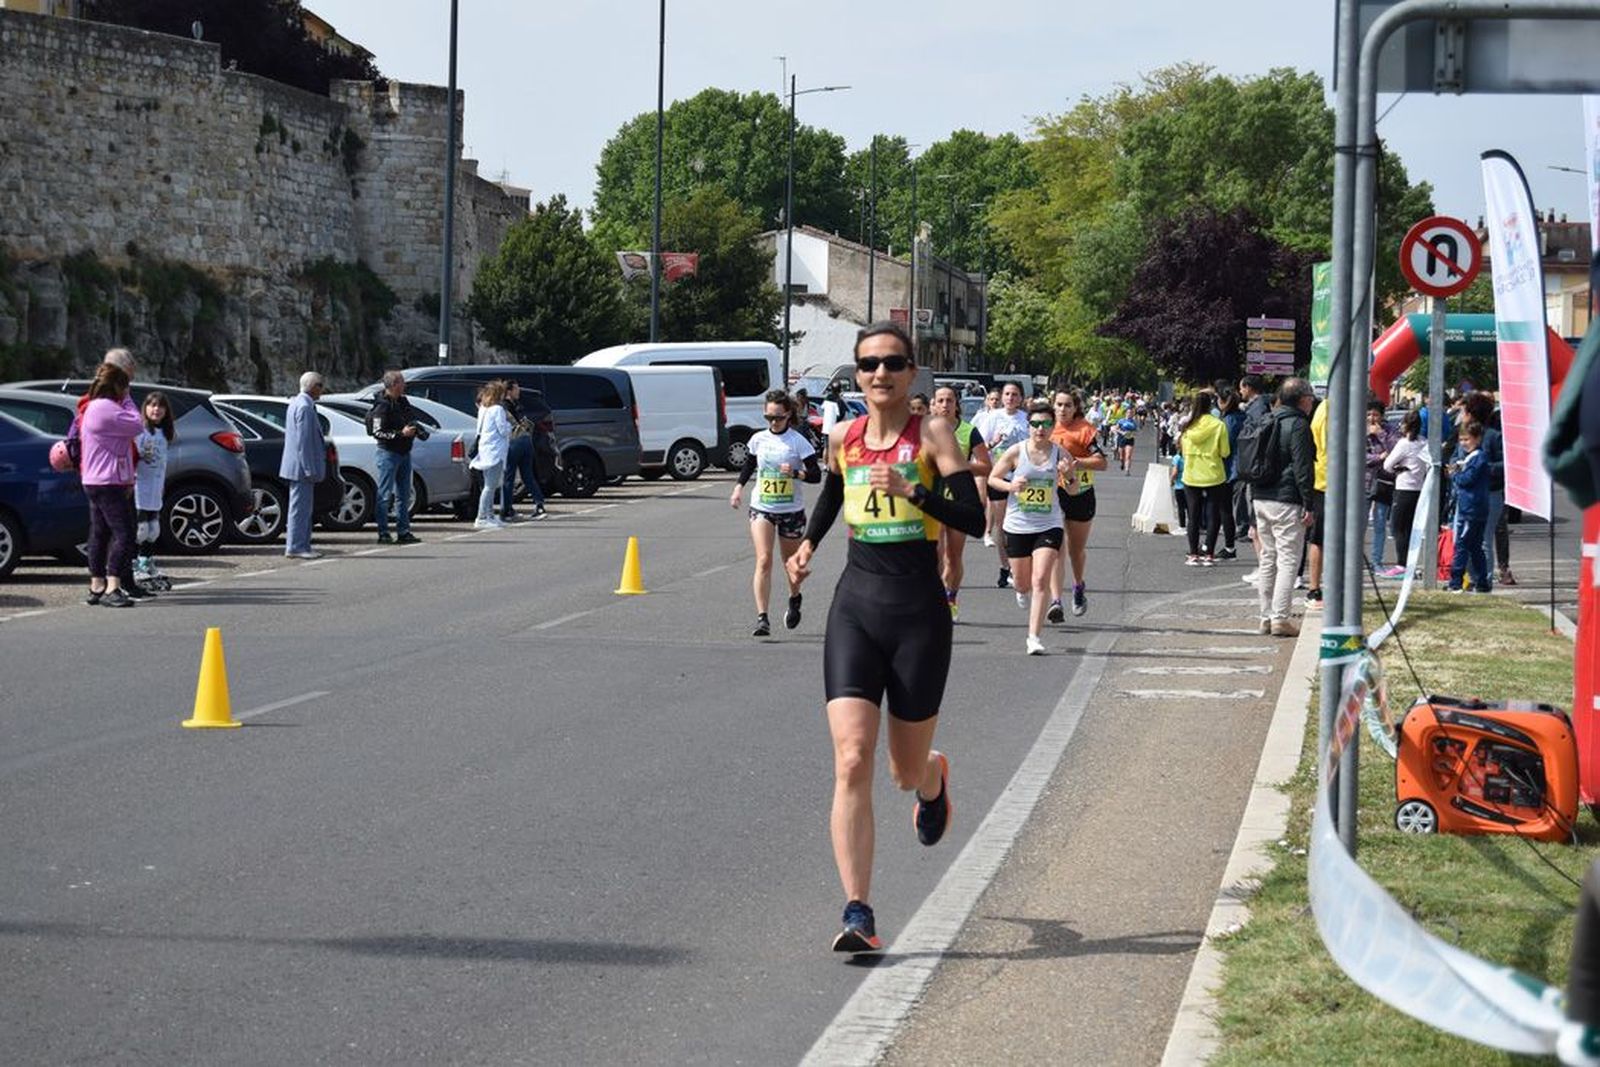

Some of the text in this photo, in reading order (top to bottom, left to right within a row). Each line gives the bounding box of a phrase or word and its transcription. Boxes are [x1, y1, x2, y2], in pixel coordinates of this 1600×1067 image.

[763, 479, 788, 494] 217
[864, 487, 897, 518] 41
[1026, 488, 1046, 503] 23
[866, 524, 920, 538] CAJA RURAL
